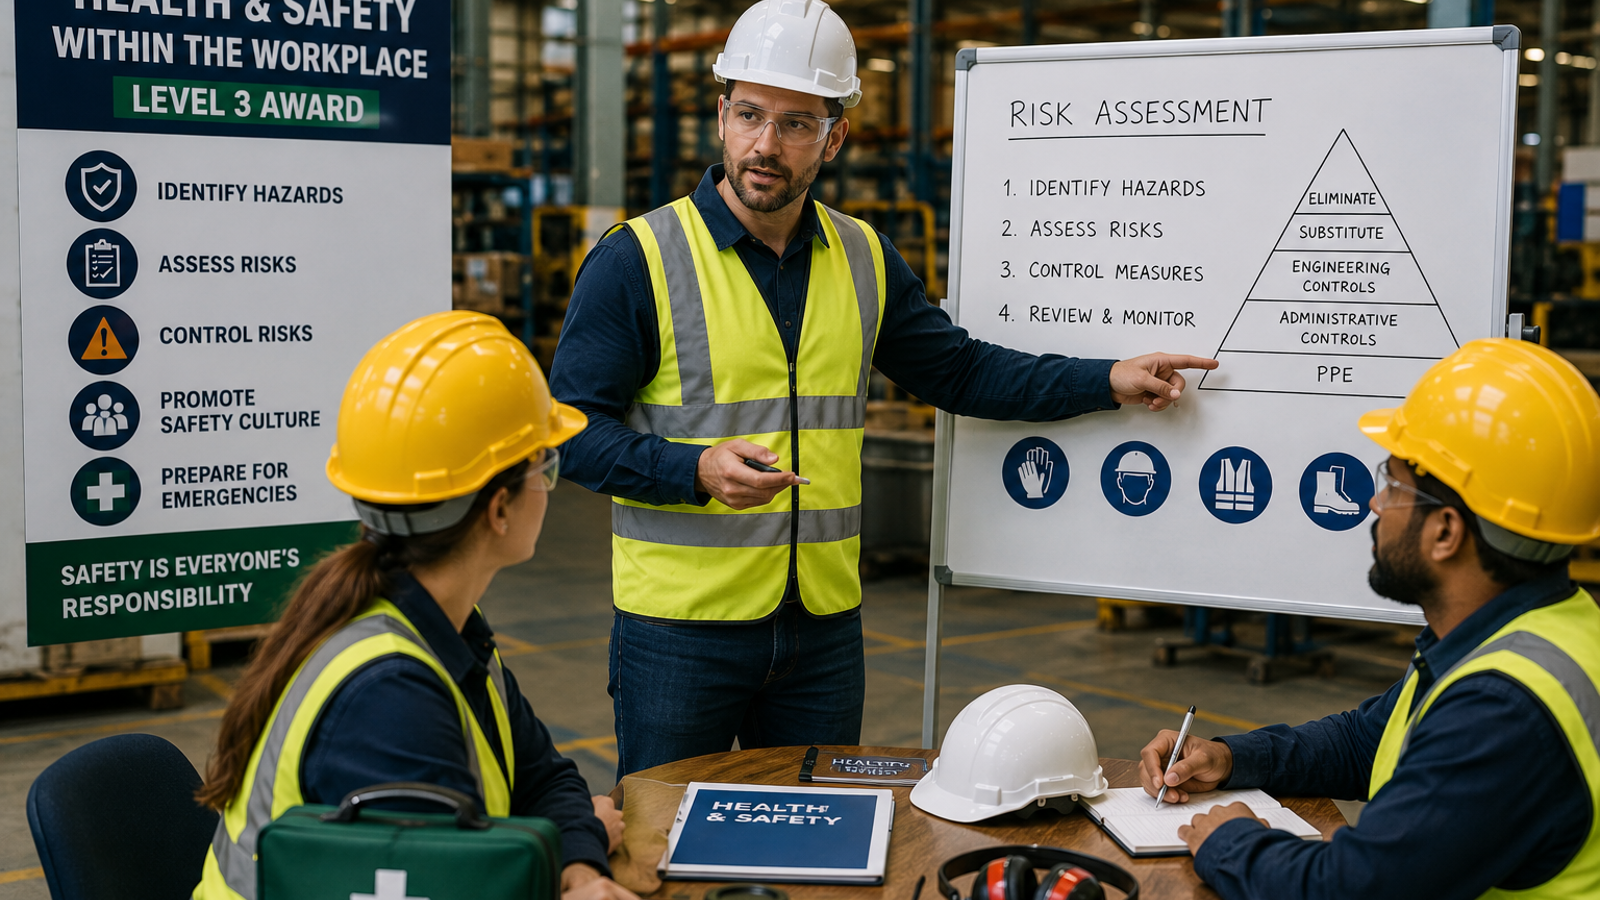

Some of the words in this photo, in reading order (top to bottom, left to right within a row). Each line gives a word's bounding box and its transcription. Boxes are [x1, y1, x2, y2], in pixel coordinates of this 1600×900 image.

[75, 0, 231, 20] LTH
[244, 0, 272, 23] &
[282, 0, 416, 33] SAFETY
[51, 25, 174, 64] WITHIN
[183, 34, 243, 68] THE
[251, 38, 428, 79] WORKPLACE
[132, 84, 226, 116] LEVEL
[234, 89, 252, 118] 3
[259, 91, 365, 123] AWARD
[1010, 100, 1073, 128] RISK
[1094, 97, 1272, 126] ASSESSMENT
[157, 181, 248, 202] IDENTIFY
[253, 184, 344, 204] HAZARDS
[1003, 178, 1017, 197] 1.
[1030, 179, 1111, 197] IDENTIFY
[1122, 179, 1206, 197] HAZARDS
[1307, 191, 1377, 206] ELIMINATE
[1001, 219, 1017, 238] 2.
[1030, 219, 1097, 238] ASSESS
[1109, 220, 1163, 239] RISKS
[1299, 225, 1384, 240] SUBSTITUTE
[158, 255, 235, 273] ASSESS
[241, 255, 297, 274] RISKS
[1000, 260, 1016, 279] 3.
[1029, 261, 1104, 279] CONTROL
[1115, 264, 1204, 282] MEASURES
[1292, 259, 1391, 276] ENGINEERING
[1302, 279, 1376, 294] CONTROLS
[998, 303, 1015, 323] 4.
[1029, 304, 1093, 324] REVIEW
[1101, 308, 1113, 325] &
[1122, 309, 1196, 328] MONITOR
[1279, 310, 1398, 327] ADMINISTRATIVE
[159, 325, 253, 345] CONTROL
[258, 324, 313, 343] RISKS
[1300, 331, 1377, 347] CONTROLS
[1317, 365, 1353, 383] PPE
[160, 388, 256, 410] PROMOTE
[160, 413, 233, 434] SAFETY
[240, 410, 321, 431] CULTURE
[161, 463, 247, 486] PREPARE
[252, 462, 289, 480] FOR
[161, 484, 298, 510] EMERGENCIES
[61, 559, 144, 586] SAFETY
[149, 557, 169, 579] IS
[175, 547, 300, 577] EVERYONE'S
[62, 582, 253, 619] RESPONSIBILITY
[706, 812, 726, 822] &
[734, 813, 842, 826] SAFETY
